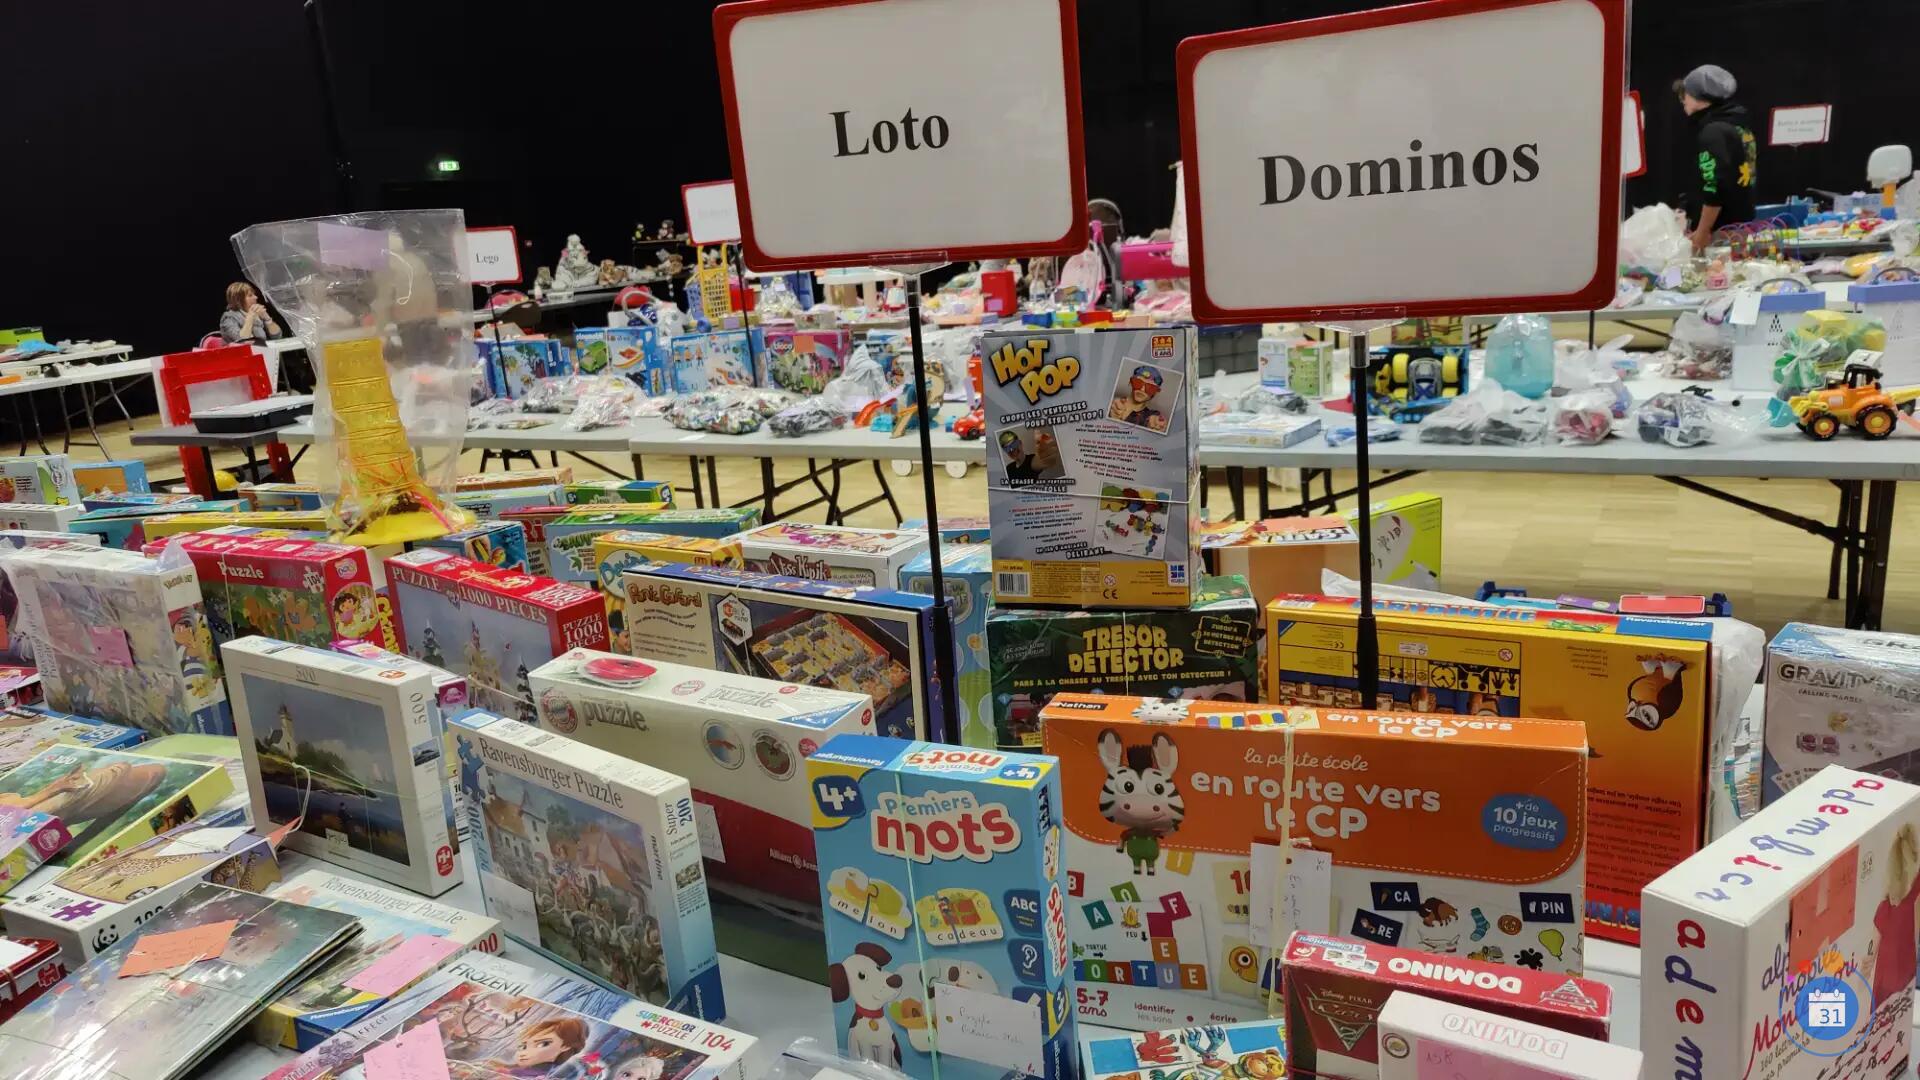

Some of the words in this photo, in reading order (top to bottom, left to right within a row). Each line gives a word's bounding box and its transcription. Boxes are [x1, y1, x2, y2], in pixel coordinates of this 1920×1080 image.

[832, 109, 950, 158] Loto
[1258, 139, 1541, 207] Dominos
[475, 252, 499, 267] Lego
[990, 339, 1049, 384] HOT
[1019, 356, 1081, 404] POP
[1082, 411, 1098, 422] TOP
[217, 562, 265, 579] Puzzle
[392, 566, 440, 592] PUZZLE
[461, 586, 492, 608] 1000
[496, 597, 548, 625] PIECES
[562, 613, 602, 633] PUZZLE
[565, 621, 604, 645] 1000
[1082, 624, 1168, 652] TRESOR
[1068, 647, 1185, 674] DETECTOR
[1045, 678, 1056, 686] LA
[1058, 677, 1090, 686] CHASSE
[1137, 673, 1159, 682] AVEC
[1161, 672, 1178, 681] TON
[1779, 663, 1874, 689] GRAVITY
[409, 691, 428, 725] 500
[582, 701, 649, 731] puzzle
[1056, 700, 1102, 710] Nathan
[1326, 712, 1362, 725] en
[1366, 714, 1443, 729] route
[1446, 717, 1514, 732] vers
[1378, 722, 1404, 735] le
[1409, 724, 1458, 739] CP
[815, 751, 885, 767] Ravensburger
[905, 750, 1007, 767] mots
[1245, 748, 1263, 764] la
[1322, 753, 1369, 772] école
[478, 737, 571, 789] Ravensburger
[574, 776, 625, 810] Puzzle
[820, 782, 858, 811] 4+
[1190, 771, 1235, 797] en
[1243, 773, 1345, 805] route
[1355, 784, 1443, 813] vers
[676, 797, 693, 827] 200
[884, 796, 973, 816] Premiers
[467, 806, 485, 841] 200
[665, 803, 678, 836] Super
[1305, 805, 1368, 840] CP
[1493, 807, 1519, 825] 10
[1519, 810, 1559, 831] jeux
[876, 809, 1015, 857] mots
[1492, 824, 1557, 843] progressifs
[650, 834, 664, 881] martine
[321, 878, 415, 915] Ravensburger
[414, 901, 464, 926] Puzzle
[1010, 897, 1039, 914] ABC
[1393, 890, 1412, 904] CA
[1541, 901, 1566, 915] PIN
[1048, 886, 1068, 972] mots
[1125, 931, 1139, 939] FEU
[1377, 923, 1395, 940] RE
[1085, 943, 1108, 951] TORTUE
[448, 963, 510, 993] FROZEN
[1387, 957, 1523, 995] DOMINO
[1076, 987, 1109, 1006] 5-7
[1348, 994, 1374, 1005] PIXAR
[635, 1009, 697, 1033] SUPERCOLOR
[1078, 1005, 1108, 1018] ans
[1134, 1002, 1176, 1016] identifier
[1152, 1014, 1173, 1025] sons
[1209, 1013, 1239, 1024] écrire
[650, 1023, 690, 1041] PUZZLE
[701, 1031, 736, 1052] 104
[1442, 1012, 1569, 1060] DOMINO
